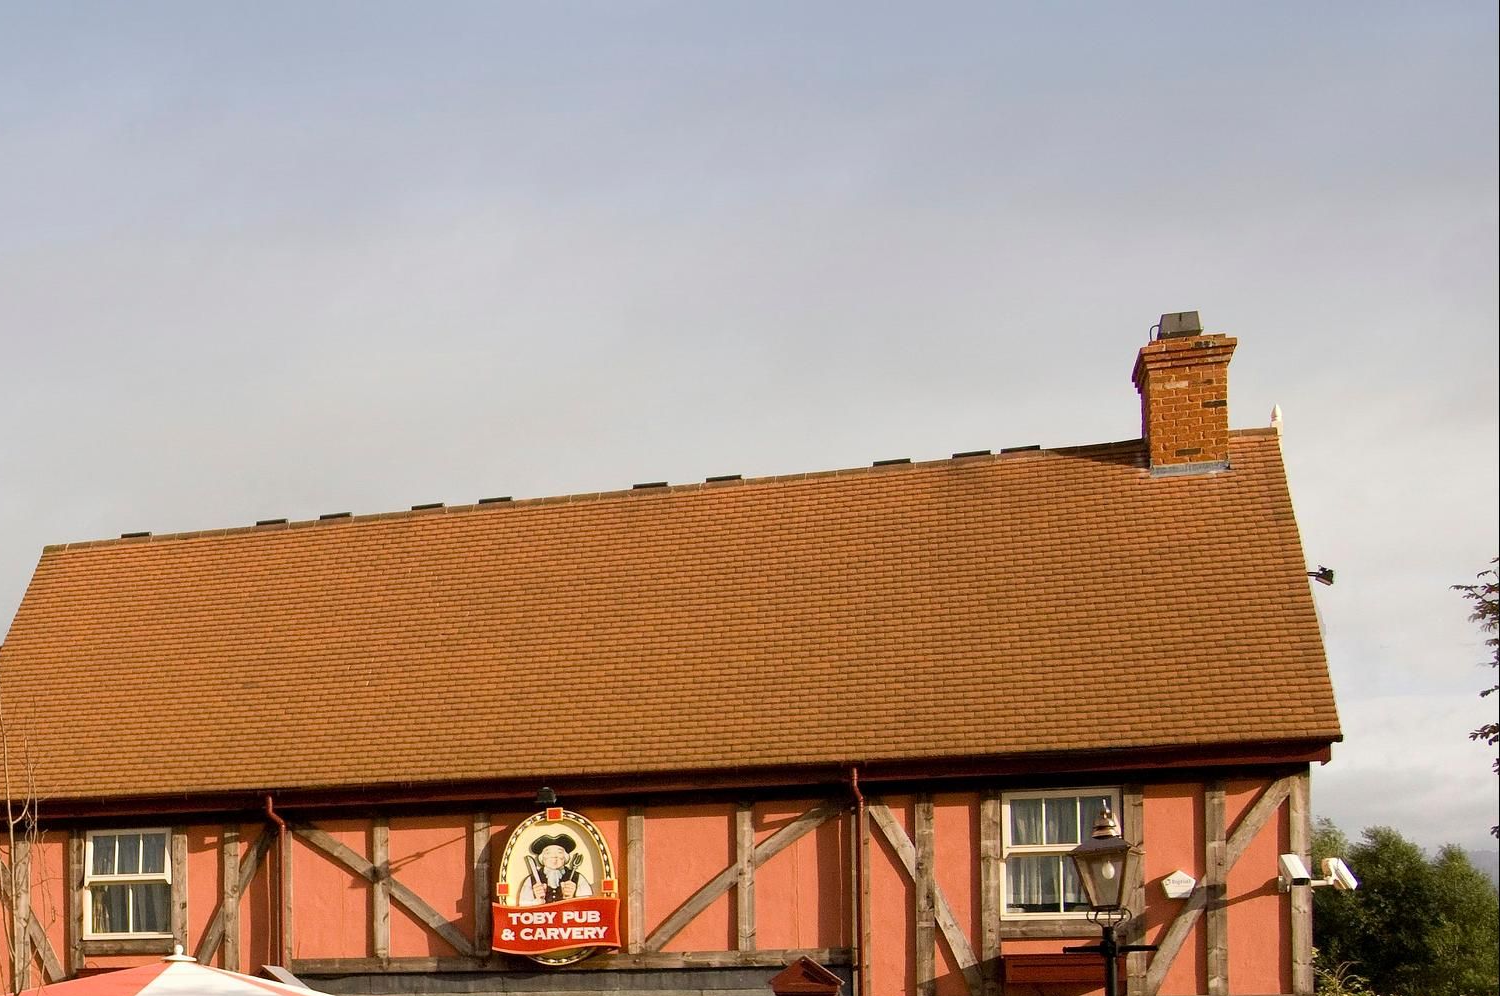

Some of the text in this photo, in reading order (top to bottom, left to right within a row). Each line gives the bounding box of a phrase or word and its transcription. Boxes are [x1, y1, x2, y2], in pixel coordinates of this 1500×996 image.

[507, 910, 600, 925] TOBY PUB
[501, 926, 608, 941] & CARVERY
